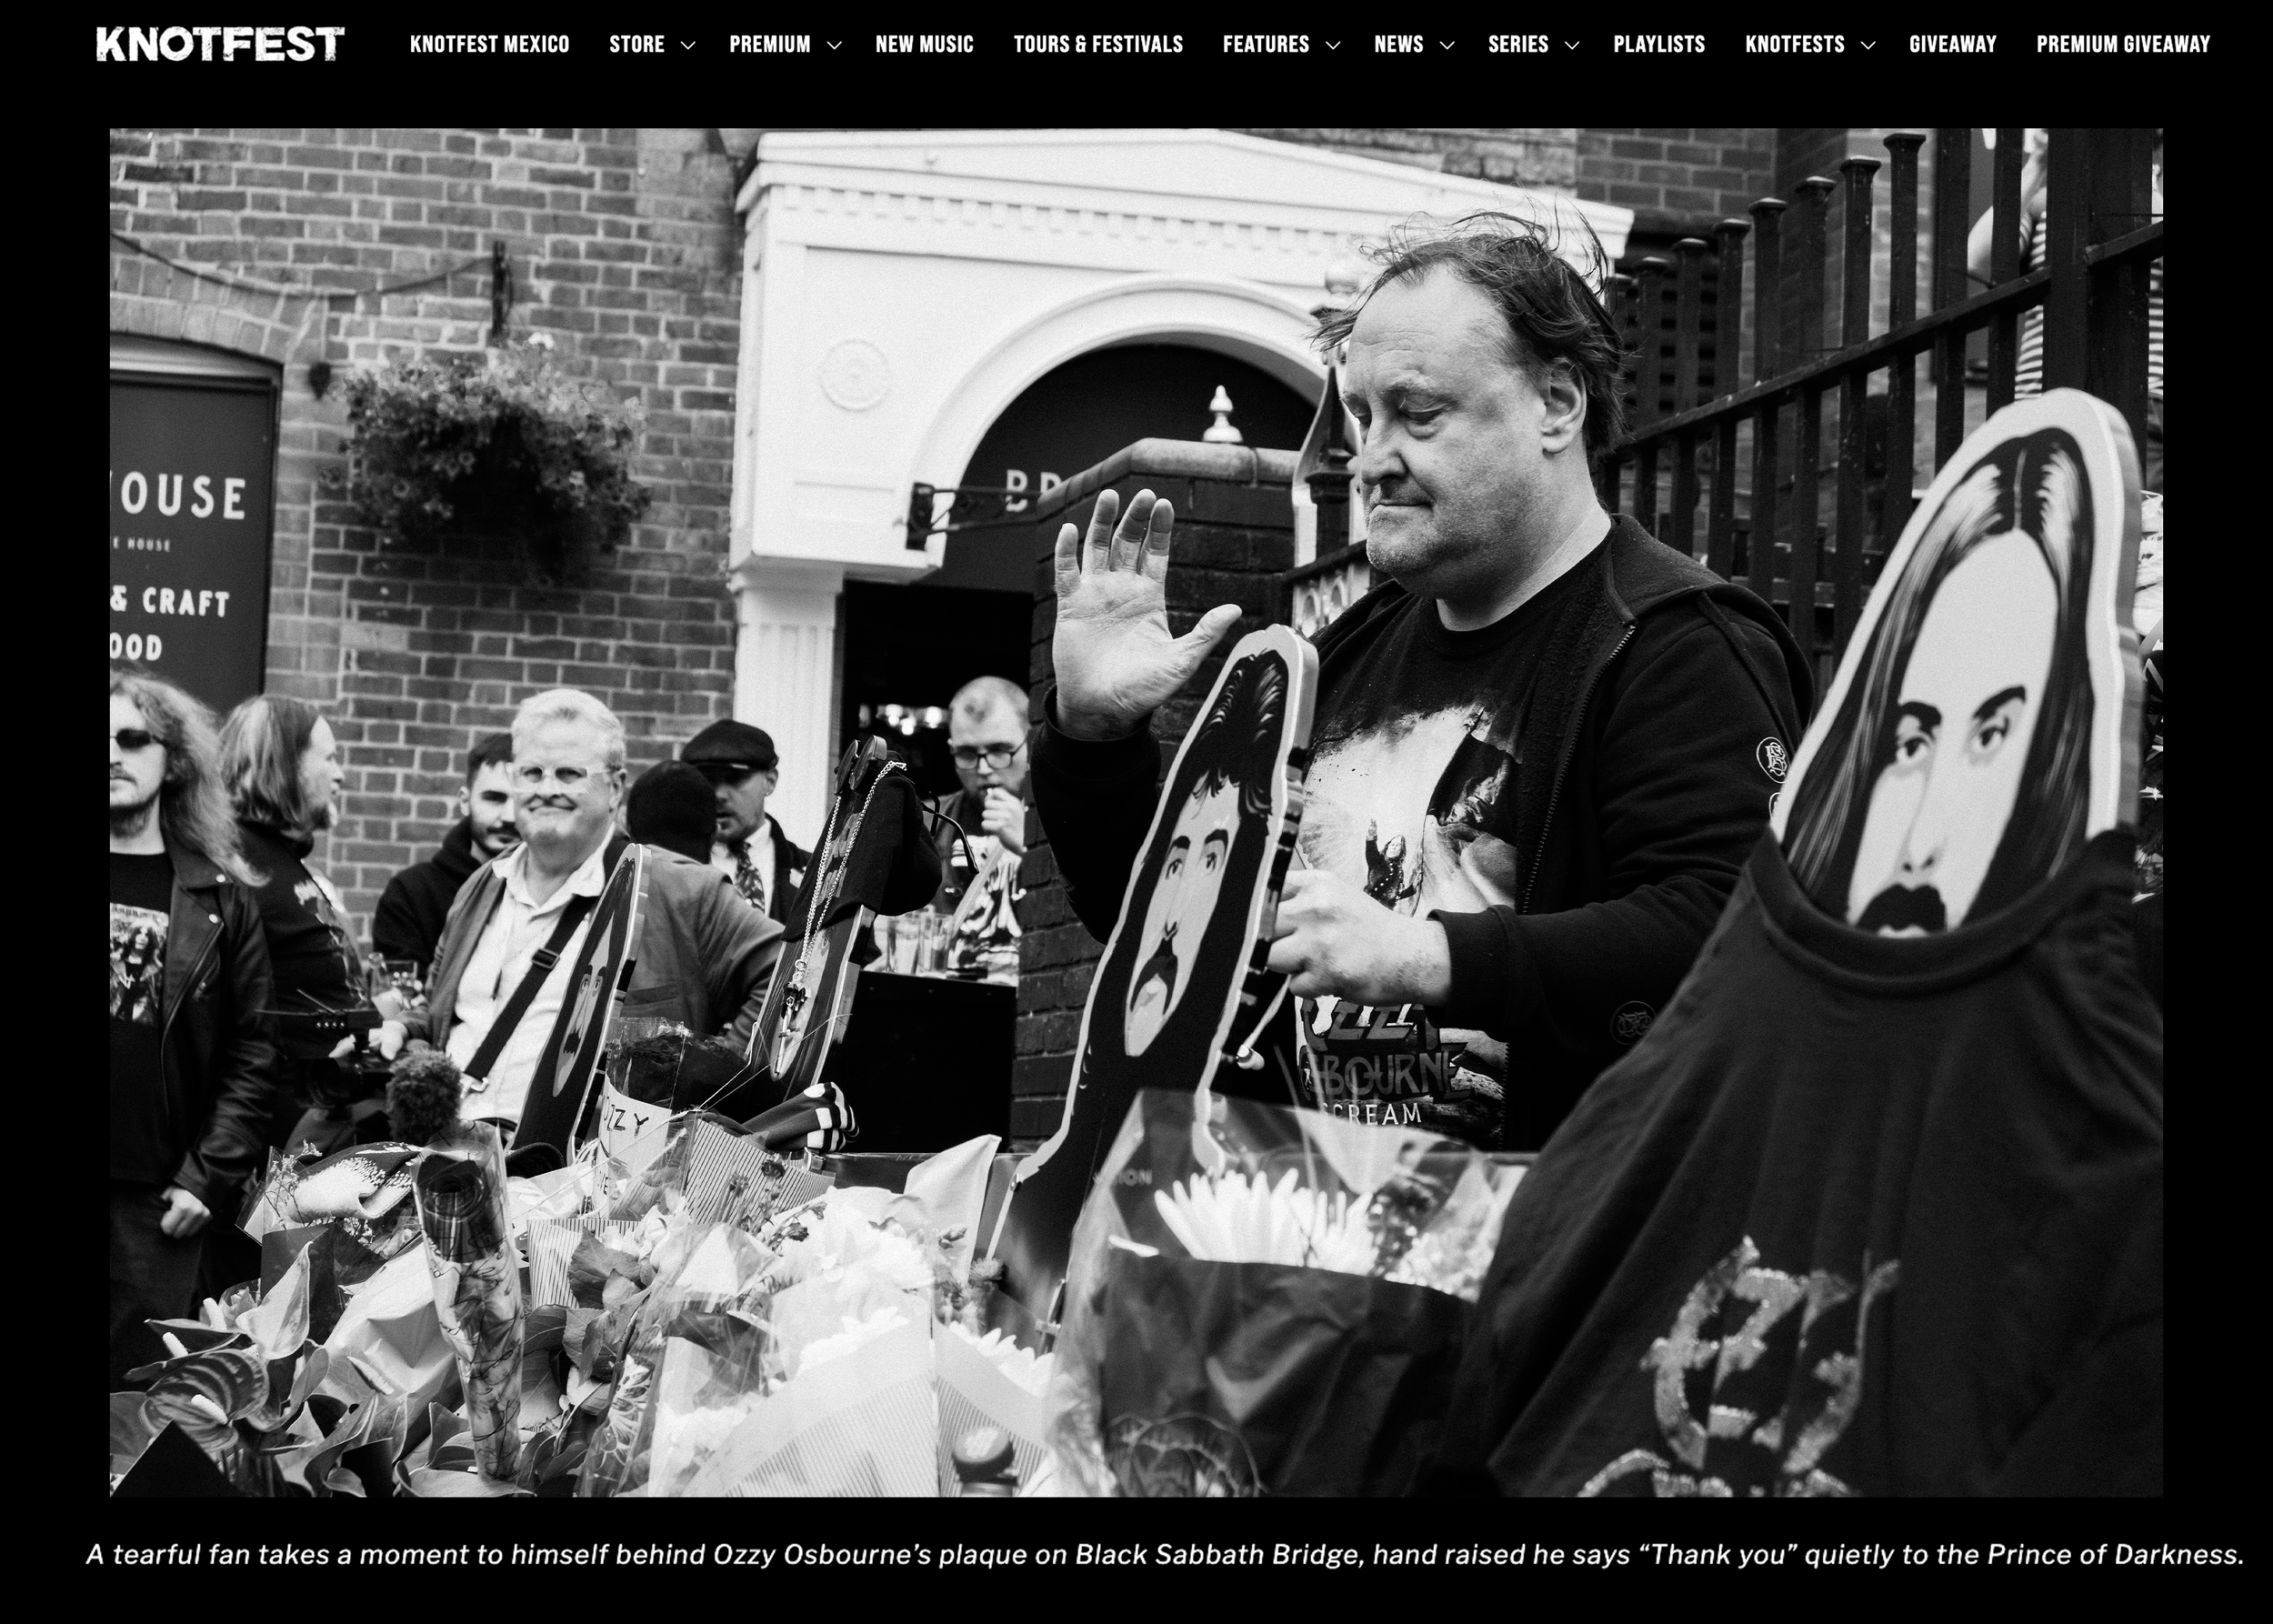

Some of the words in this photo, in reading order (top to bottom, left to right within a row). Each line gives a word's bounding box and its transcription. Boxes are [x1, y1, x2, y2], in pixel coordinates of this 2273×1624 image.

[110, 470, 245, 520] OUSE
[127, 536, 171, 553] HOUSE
[110, 585, 127, 612] &
[143, 586, 230, 618] CRAFT
